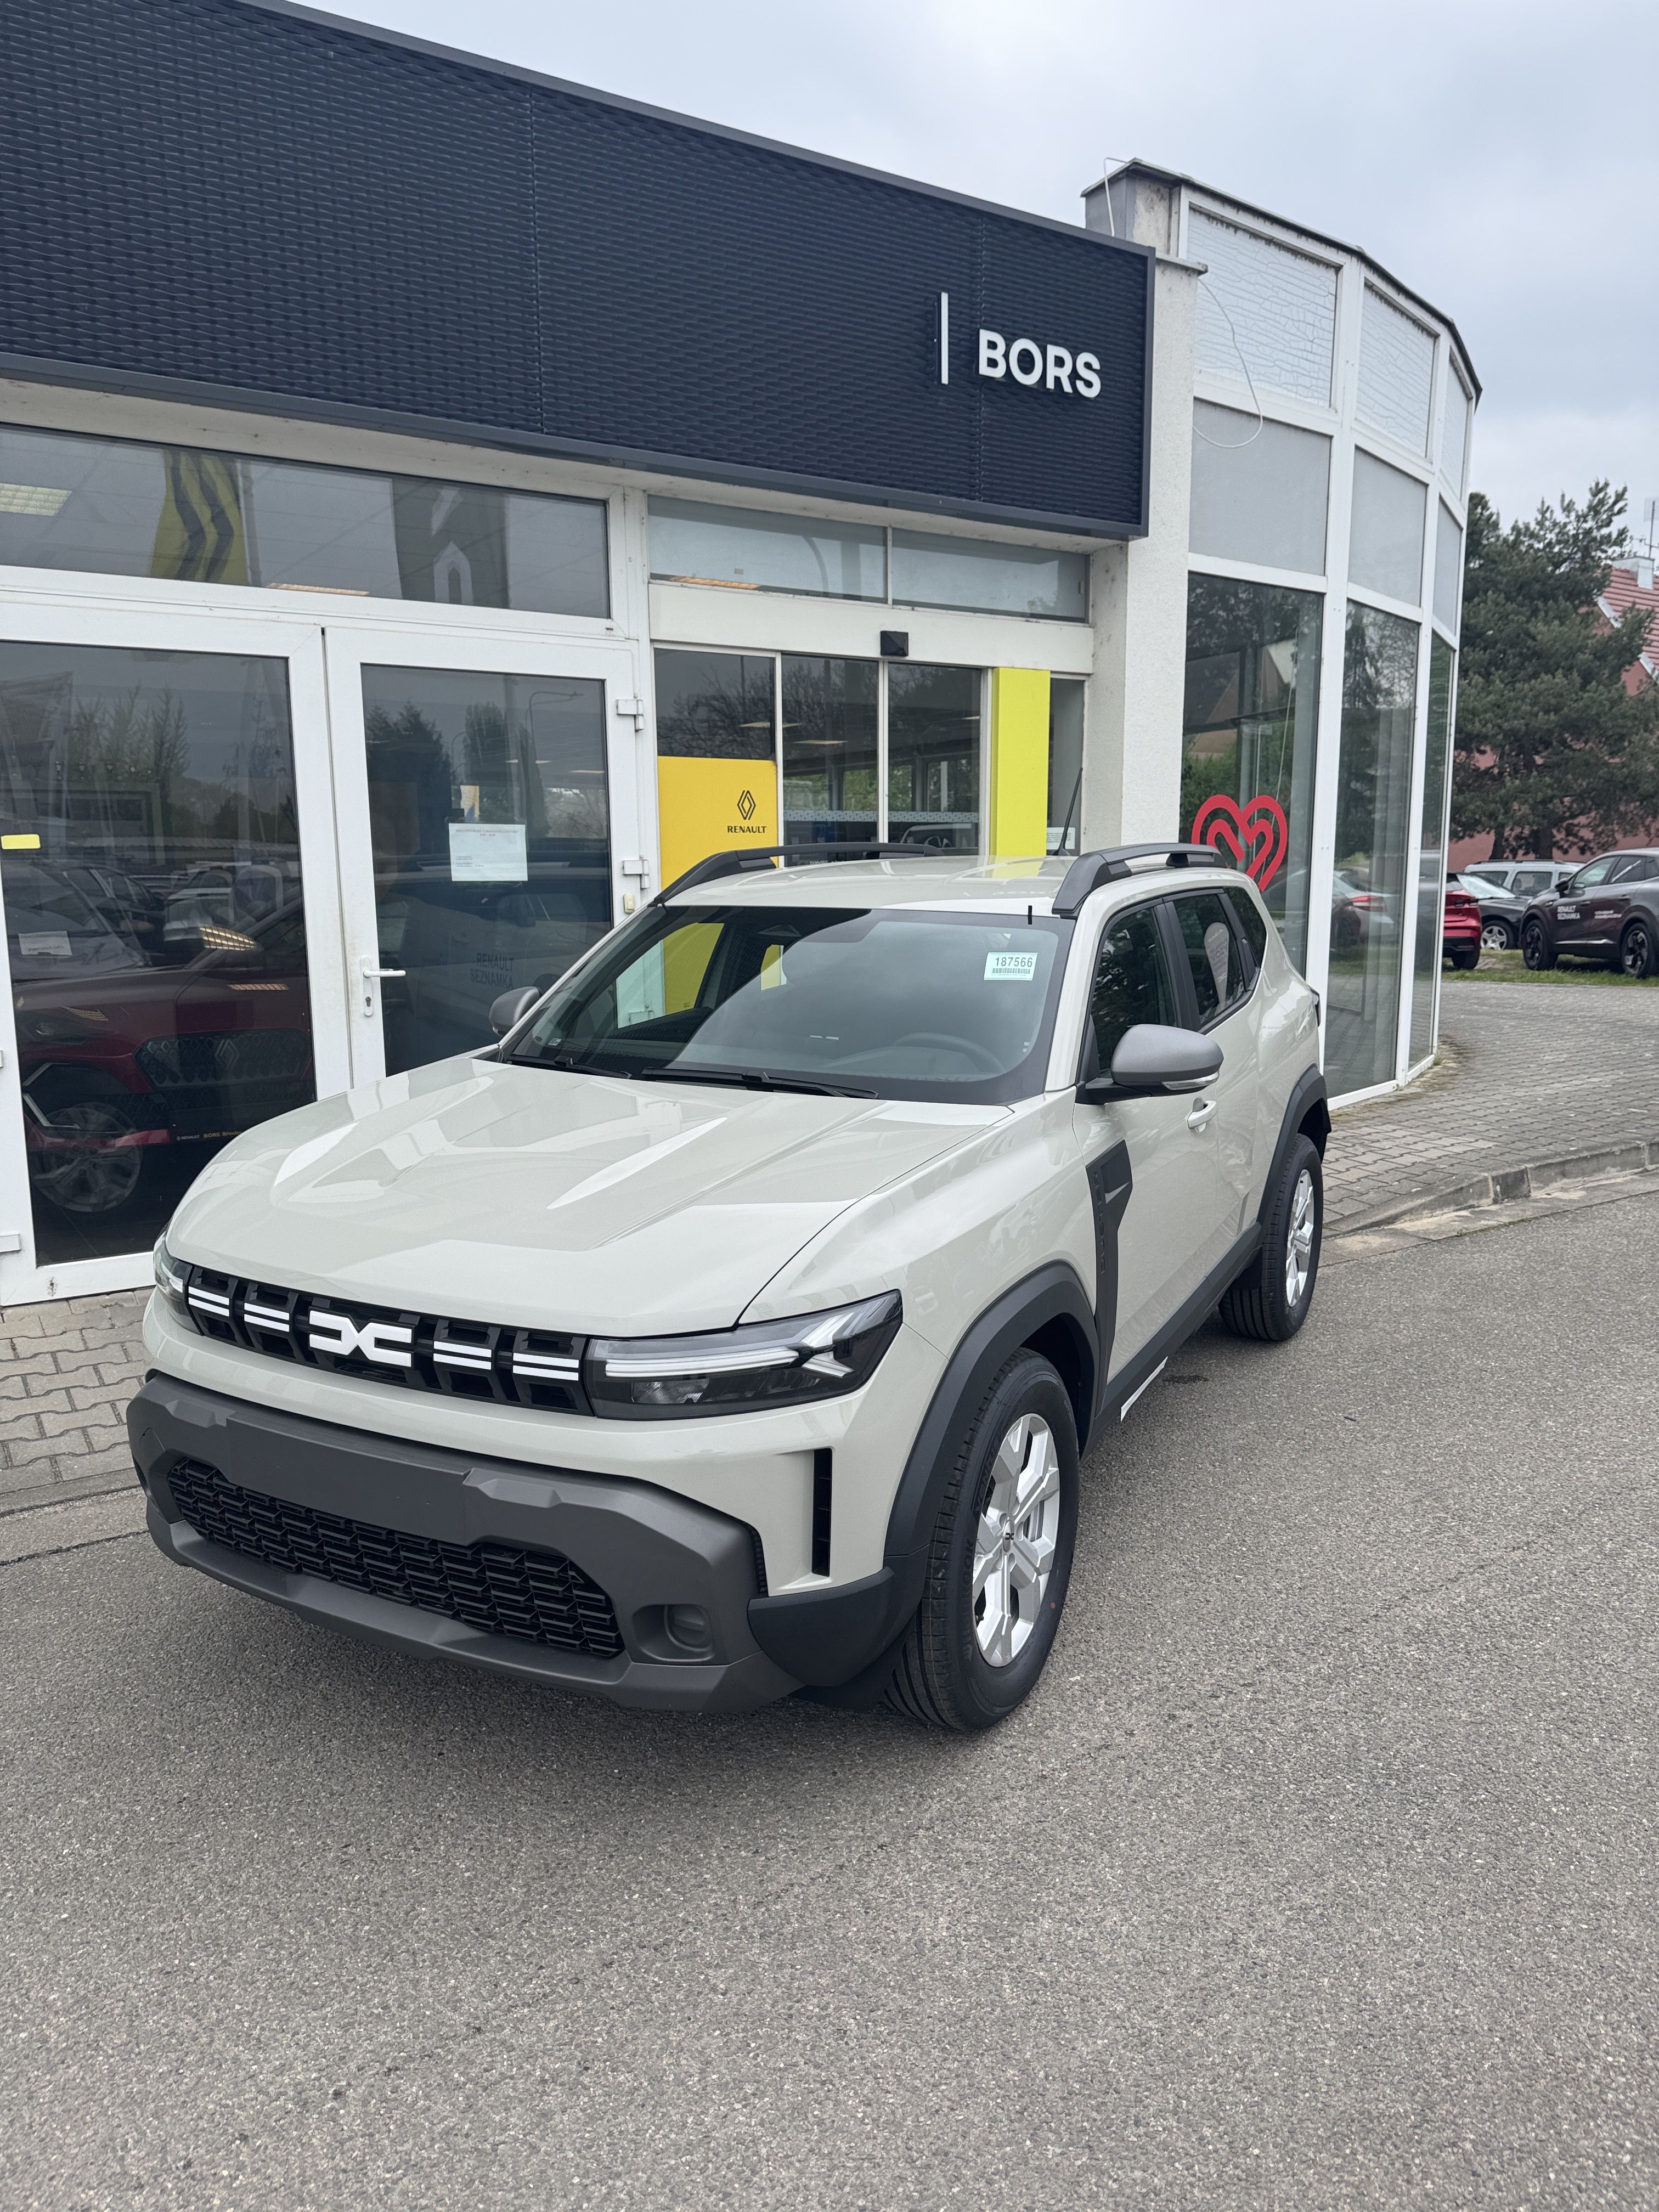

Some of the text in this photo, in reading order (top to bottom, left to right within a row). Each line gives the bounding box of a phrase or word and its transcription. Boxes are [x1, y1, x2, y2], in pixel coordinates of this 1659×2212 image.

[979, 329, 1101, 398] BORS
[727, 825, 767, 833] RENAULT
[477, 953, 514, 972] RENAULT
[995, 957, 1032, 967] 187566
[470, 968, 514, 988] SEZNAMKA
